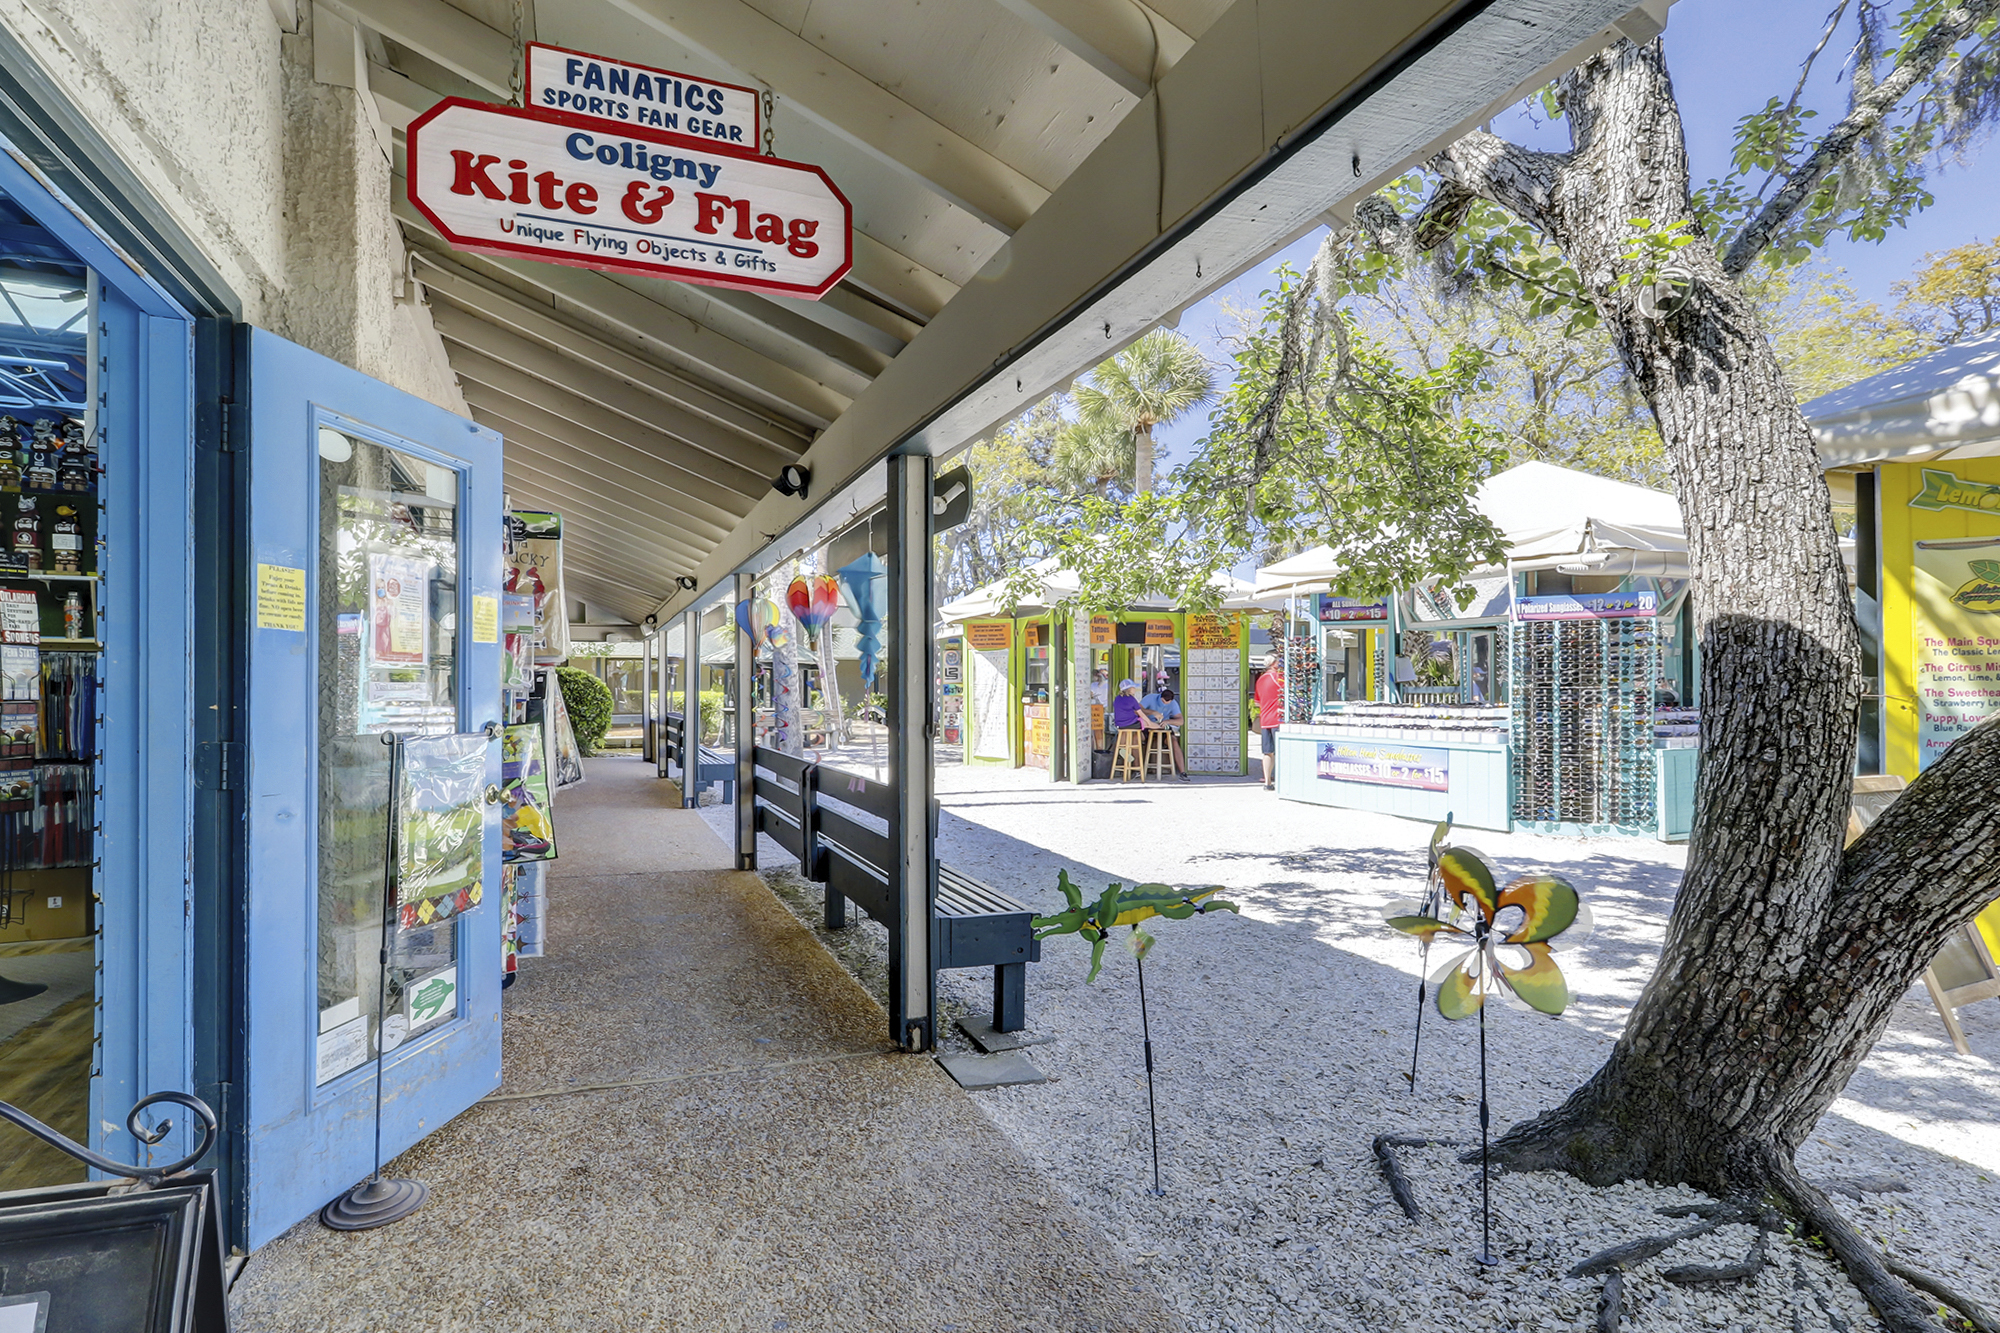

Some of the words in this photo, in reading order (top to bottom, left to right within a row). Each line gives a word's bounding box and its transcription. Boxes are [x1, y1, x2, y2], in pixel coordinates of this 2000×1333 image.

[566, 58, 724, 115] FANATICS
[542, 88, 629, 120] SPORTS
[638, 106, 679, 129] FAN
[687, 116, 744, 143] GEAR
[566, 132, 722, 188] Coligny
[450, 150, 598, 215] Kite
[620, 180, 674, 225] &
[694, 191, 819, 259] Flag
[499, 217, 564, 243] Unique
[574, 229, 628, 255] Flying
[636, 239, 706, 263] Objects
[716, 251, 728, 265] &
[734, 253, 777, 273] Gifts
[1521, 603, 1549, 614] Polarized
[1549, 602, 1584, 614] Sunglasses
[1587, 598, 1605, 612] $12
[1615, 601, 1622, 611] 2
[1623, 600, 1634, 610] for
[1634, 596, 1653, 610] $20
[1325, 609, 1340, 620] $10
[1349, 611, 1355, 619] 2
[1366, 608, 1382, 619] $15
[1924, 638, 1943, 647] The
[1947, 637, 1973, 646] Main
[1933, 648, 1948, 656] The
[1952, 648, 1984, 656] Classic
[1924, 663, 1944, 672] The
[1947, 663, 1982, 672] Citrus
[1933, 674, 1966, 682] Lemon,
[1968, 674, 1993, 682] Lime,
[1925, 689, 1944, 697] The
[1933, 699, 1985, 708] Strawberry
[1926, 713, 1958, 724] Puppy
[1934, 724, 1953, 732] Blue
[1926, 739, 1955, 748] Arno
[1336, 745, 1357, 757] Hilton
[1359, 747, 1377, 759] Head
[1379, 748, 1422, 765] Sunglasses
[1320, 760, 1329, 773] ALL
[1330, 761, 1372, 777] SUNGLASSES
[1373, 763, 1392, 779] $10
[1401, 766, 1410, 781] 2
[1411, 768, 1423, 781] for
[1424, 766, 1445, 785] $15
